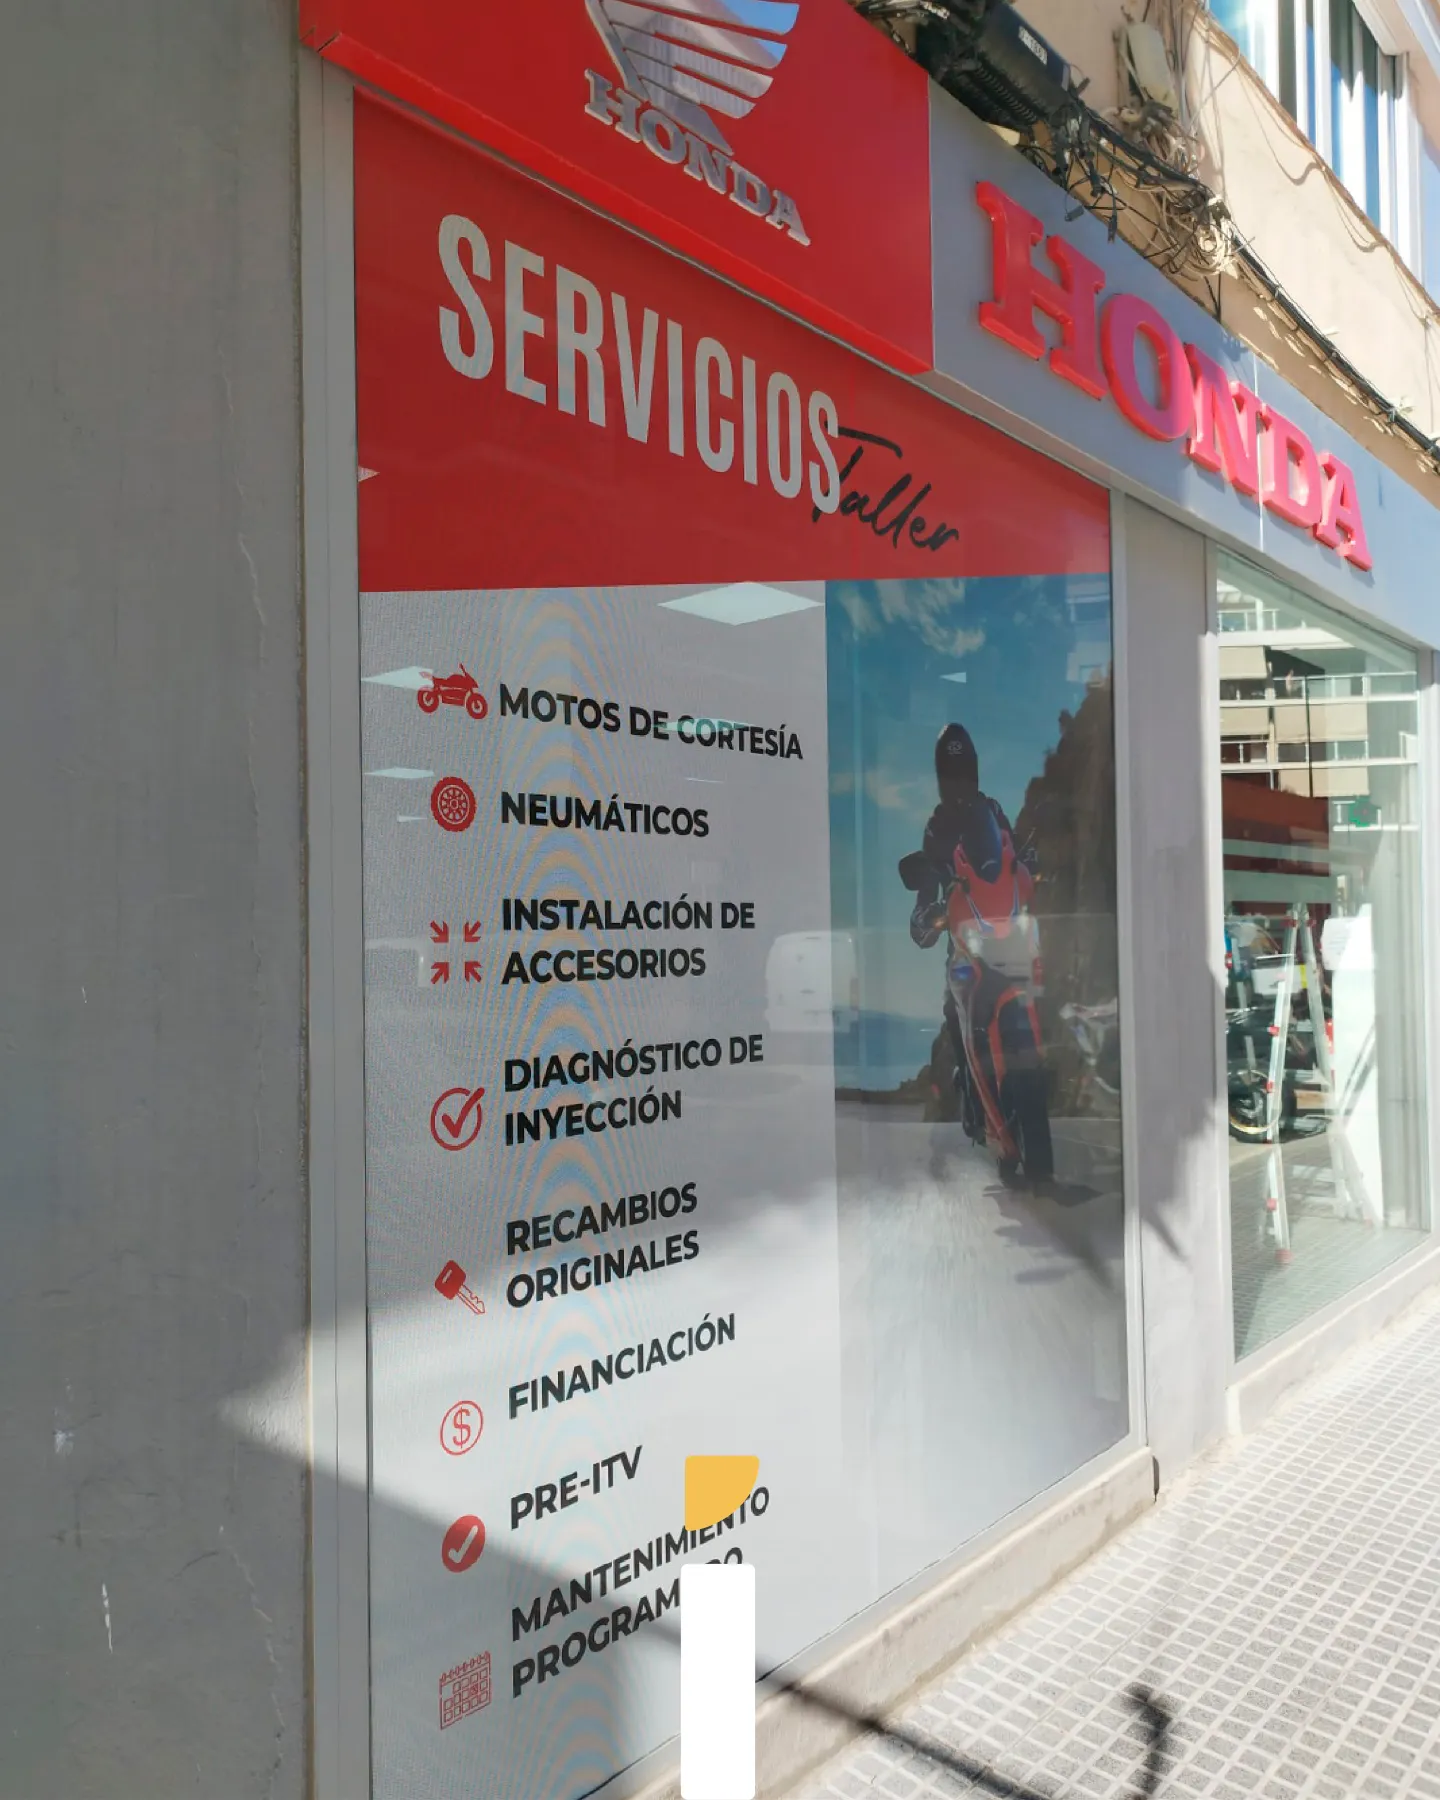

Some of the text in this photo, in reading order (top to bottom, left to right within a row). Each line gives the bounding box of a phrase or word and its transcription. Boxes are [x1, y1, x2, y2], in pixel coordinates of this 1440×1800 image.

[584, 69, 811, 246] HONDA
[438, 214, 840, 515] SERVICIOS
[976, 181, 1373, 571] HONDA
[811, 420, 960, 551] Taller
[499, 684, 803, 760] MOTOS DE CORTESÍA
[501, 792, 709, 838] NEUMÁTICOS
[502, 893, 755, 931] INSTALACIÓN DE
[501, 948, 706, 985] ACCESORIOS
[504, 1034, 764, 1093] DIAGNÓSTICO DE
[505, 1085, 682, 1146] INYECCIÓN
[506, 1182, 698, 1256] RECAMBIOS
[506, 1230, 699, 1309] ORIGINALES
[509, 1313, 735, 1420] FINANCIACIÓN
[511, 1445, 643, 1529] PRE-ITV
[512, 1547, 743, 1698] PROGRAMO
